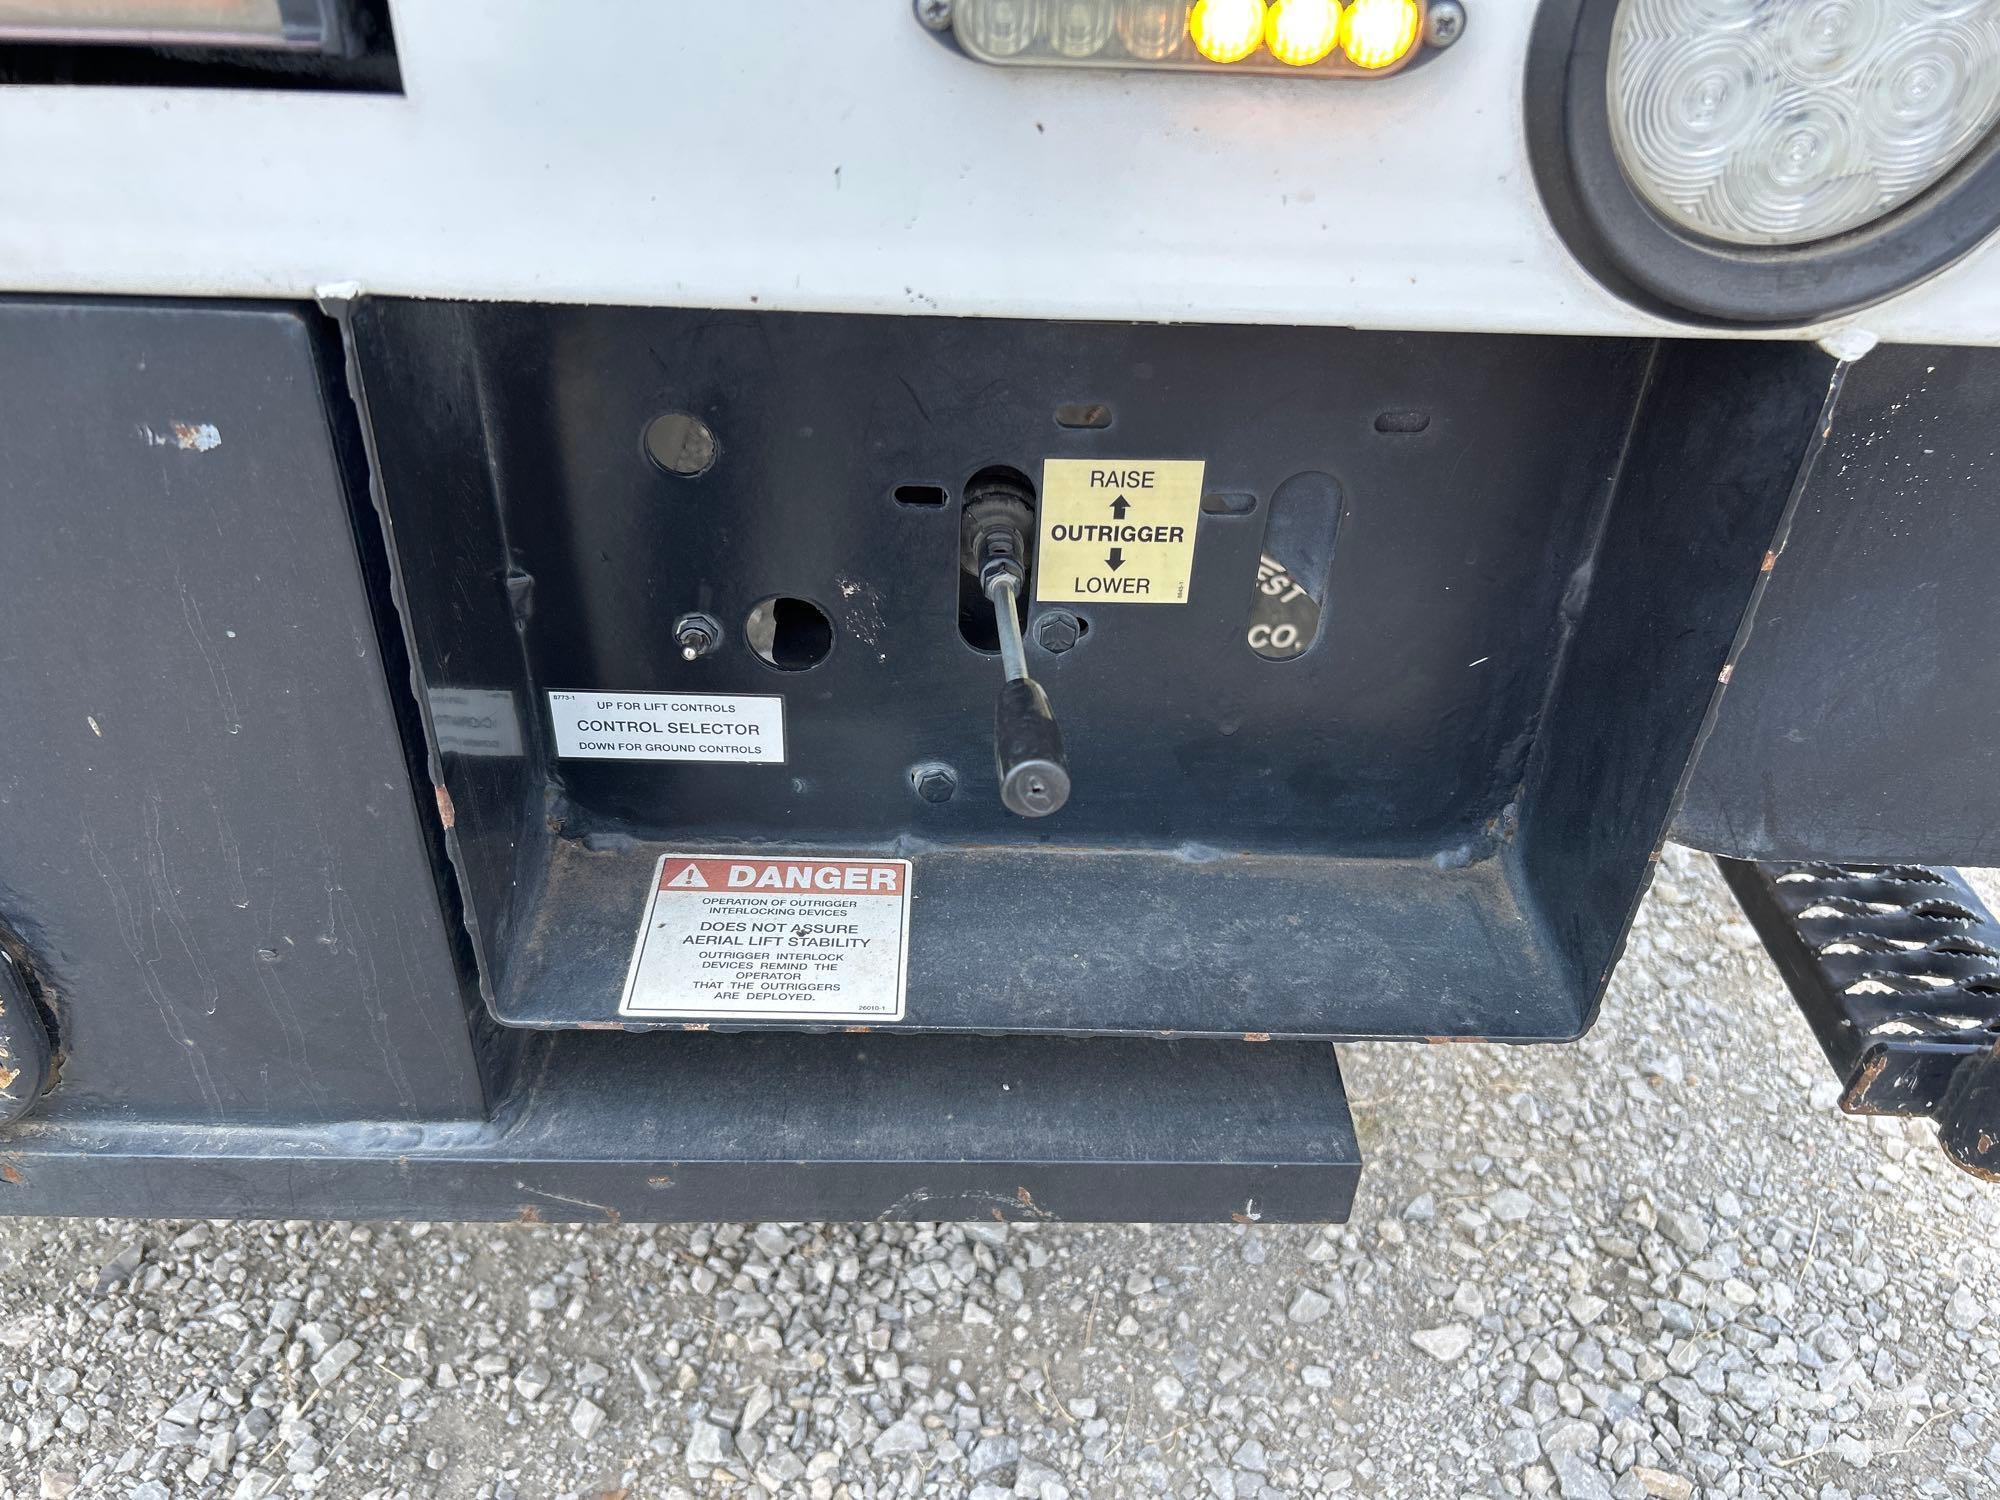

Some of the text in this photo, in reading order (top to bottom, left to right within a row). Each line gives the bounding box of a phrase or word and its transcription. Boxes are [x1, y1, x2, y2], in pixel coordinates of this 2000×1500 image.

[1090, 470, 1155, 488] RAISE
[1051, 524, 1184, 543] OUTRIGGER
[1074, 577, 1151, 594] LOWER
[1247, 624, 1302, 651] CO.
[597, 702, 736, 713] UP FOR LIFT CONTROLS
[577, 720, 760, 736] CONTROL SELECTOR
[579, 741, 762, 755] DOWN FOR GROUND CONTROLS
[727, 864, 897, 891] DANGER
[702, 897, 858, 909] OPERATION OF OUTRIGGER
[708, 907, 848, 918] INTERLOCKING DEVICES
[700, 921, 859, 935] DOES NOT ASSURE
[682, 935, 871, 948] AERIAL LIFT STABILITY
[699, 951, 844, 962] OUTRIGGER INTERLOCK
[702, 961, 838, 971] DEVICES REMIND THE
[735, 971, 801, 981] OPERATOR
[693, 981, 841, 992] THAT THE OUTRIGGERS
[714, 992, 816, 1002] ARE DEPLOYED.
